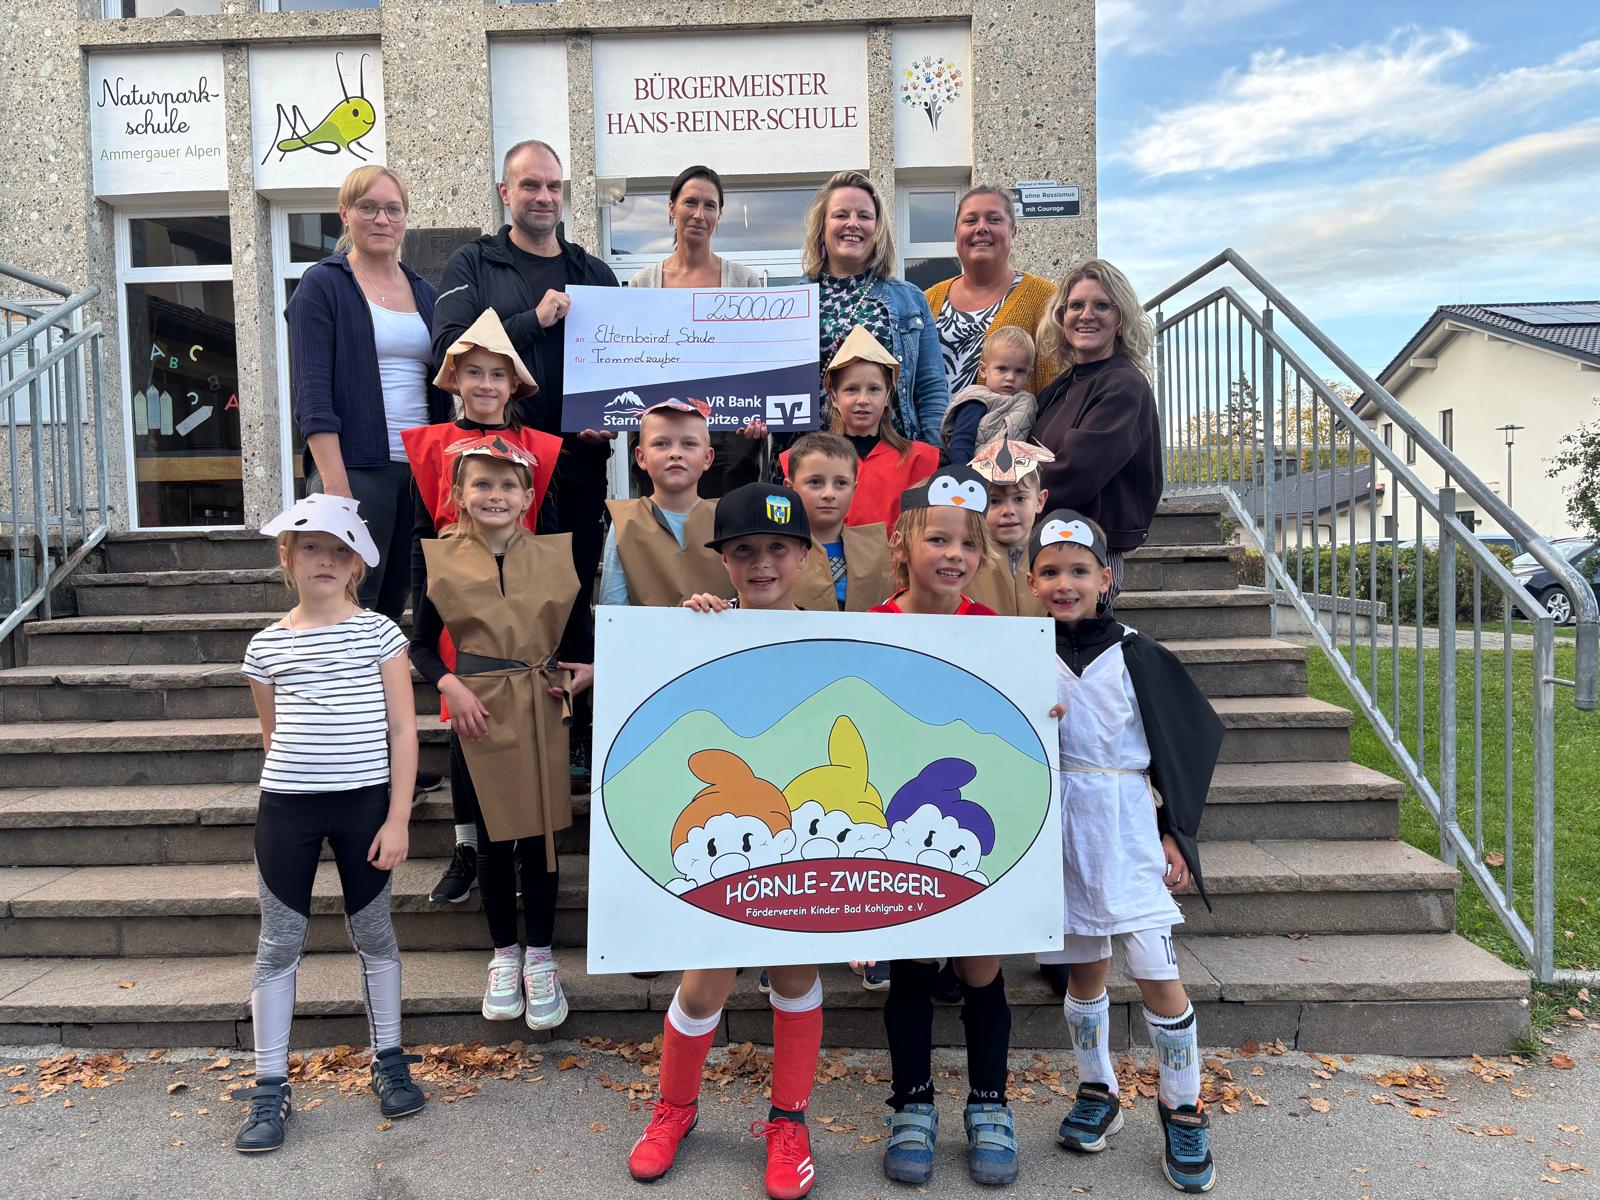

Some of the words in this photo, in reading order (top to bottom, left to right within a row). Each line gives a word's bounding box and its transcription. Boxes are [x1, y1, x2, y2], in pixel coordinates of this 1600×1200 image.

[97, 76, 219, 117] Naturpark-
[634, 72, 828, 101] BÜRGERMEISTER
[125, 108, 190, 135] schule
[606, 106, 858, 135] HANS-REINER-SCHULE
[100, 148, 180, 162] Ammergauer
[185, 145, 221, 160] Alpen
[594, 324, 671, 344] Elternbeirat
[676, 327, 716, 346] Schule
[575, 356, 586, 364] für
[591, 346, 680, 368] Trommelzauber
[706, 396, 725, 408] VR
[728, 394, 762, 408] Bank
[603, 415, 642, 426] Starn
[706, 413, 739, 427] pitze
[726, 870, 946, 906] HÖRNLE-ZWERGERL
[746, 906, 807, 917] Förderverein
[810, 904, 840, 915] Kinder
[844, 904, 861, 914] Bad
[865, 902, 904, 914] Kohlgrub
